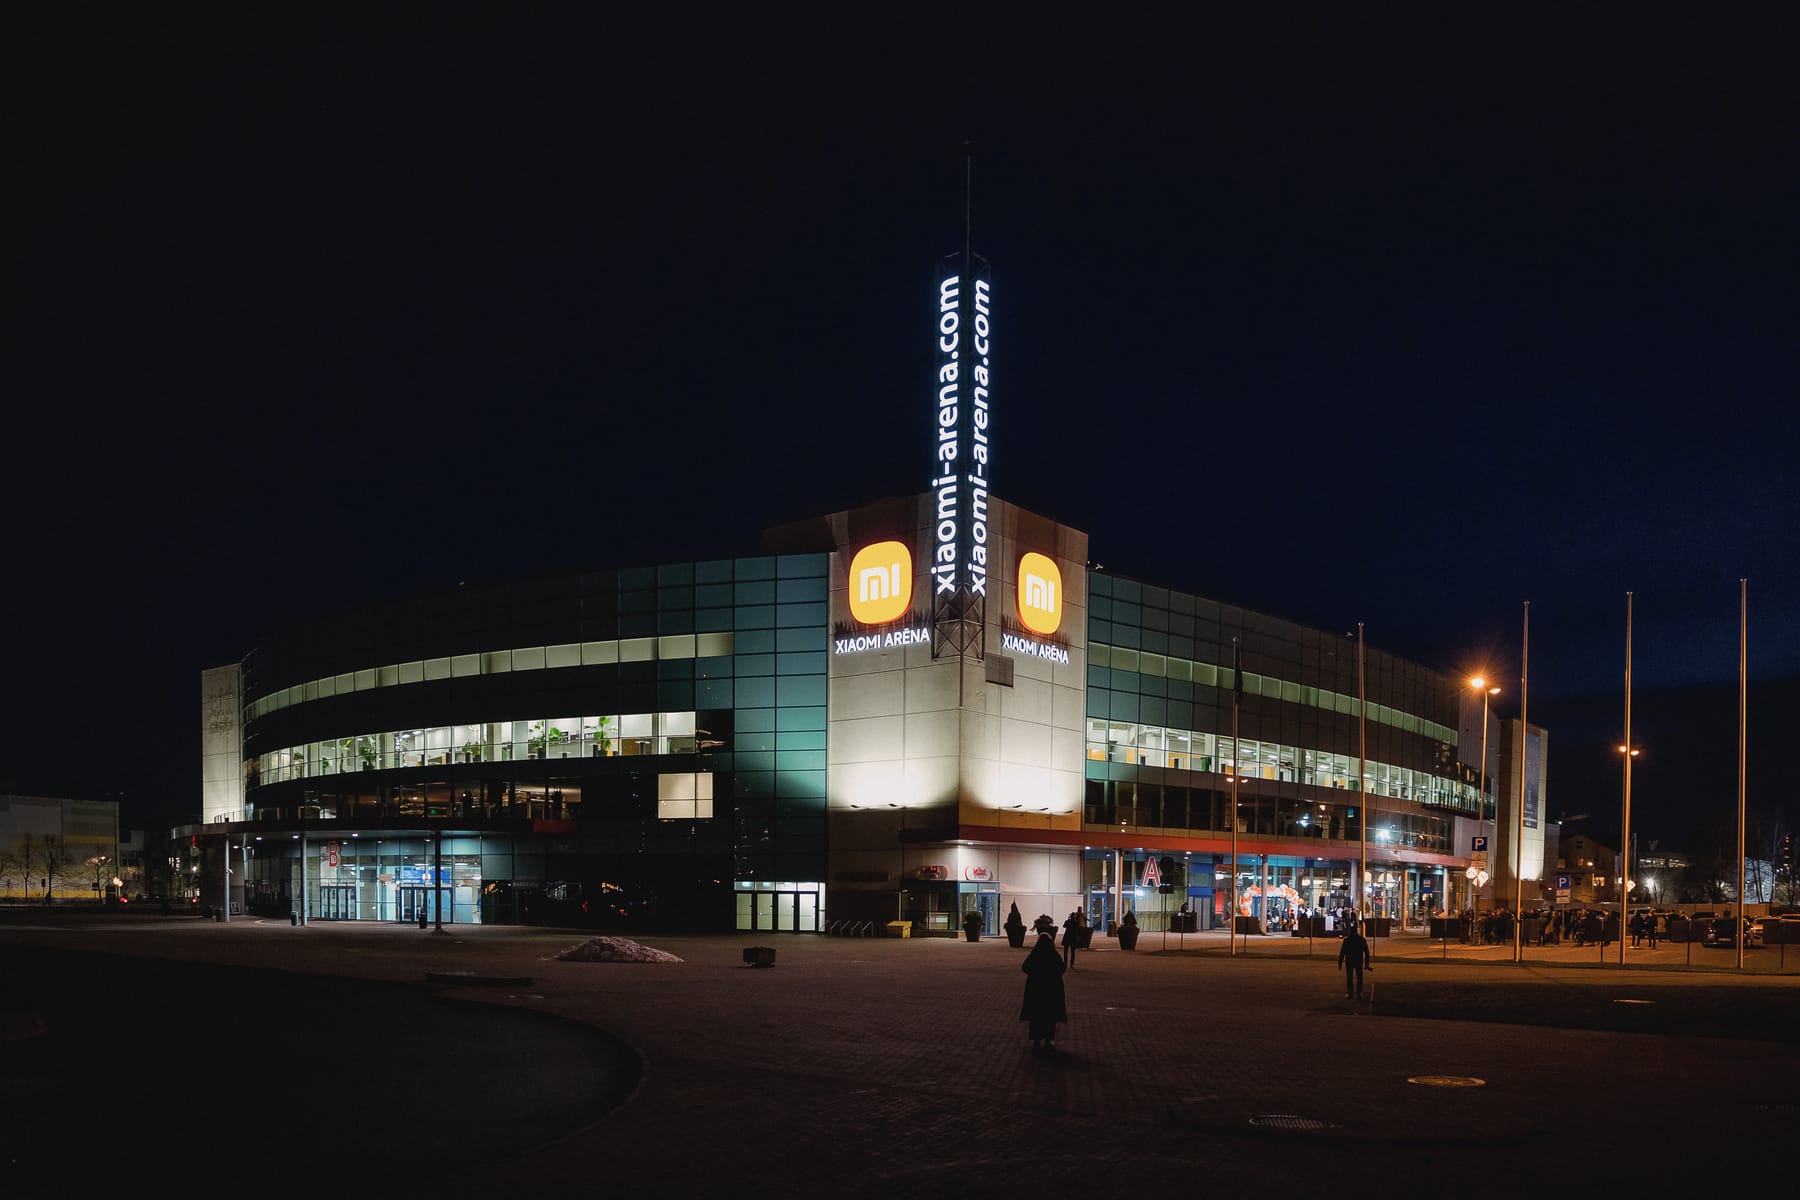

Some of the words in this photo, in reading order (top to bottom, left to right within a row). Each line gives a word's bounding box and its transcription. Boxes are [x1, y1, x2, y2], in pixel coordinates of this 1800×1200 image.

[931, 275, 960, 594] xiaomi-arena.com
[968, 279, 990, 597] xiaomi-arena.com
[835, 636, 880, 654] XIAOMI
[884, 627, 930, 648] ARĒNA
[1002, 634, 1037, 655] XIAOMI
[1039, 645, 1069, 664] ARĒNA
[329, 841, 339, 867] B
[1475, 838, 1484, 849] P
[1143, 856, 1161, 887] A
[1559, 878, 1567, 887] P
